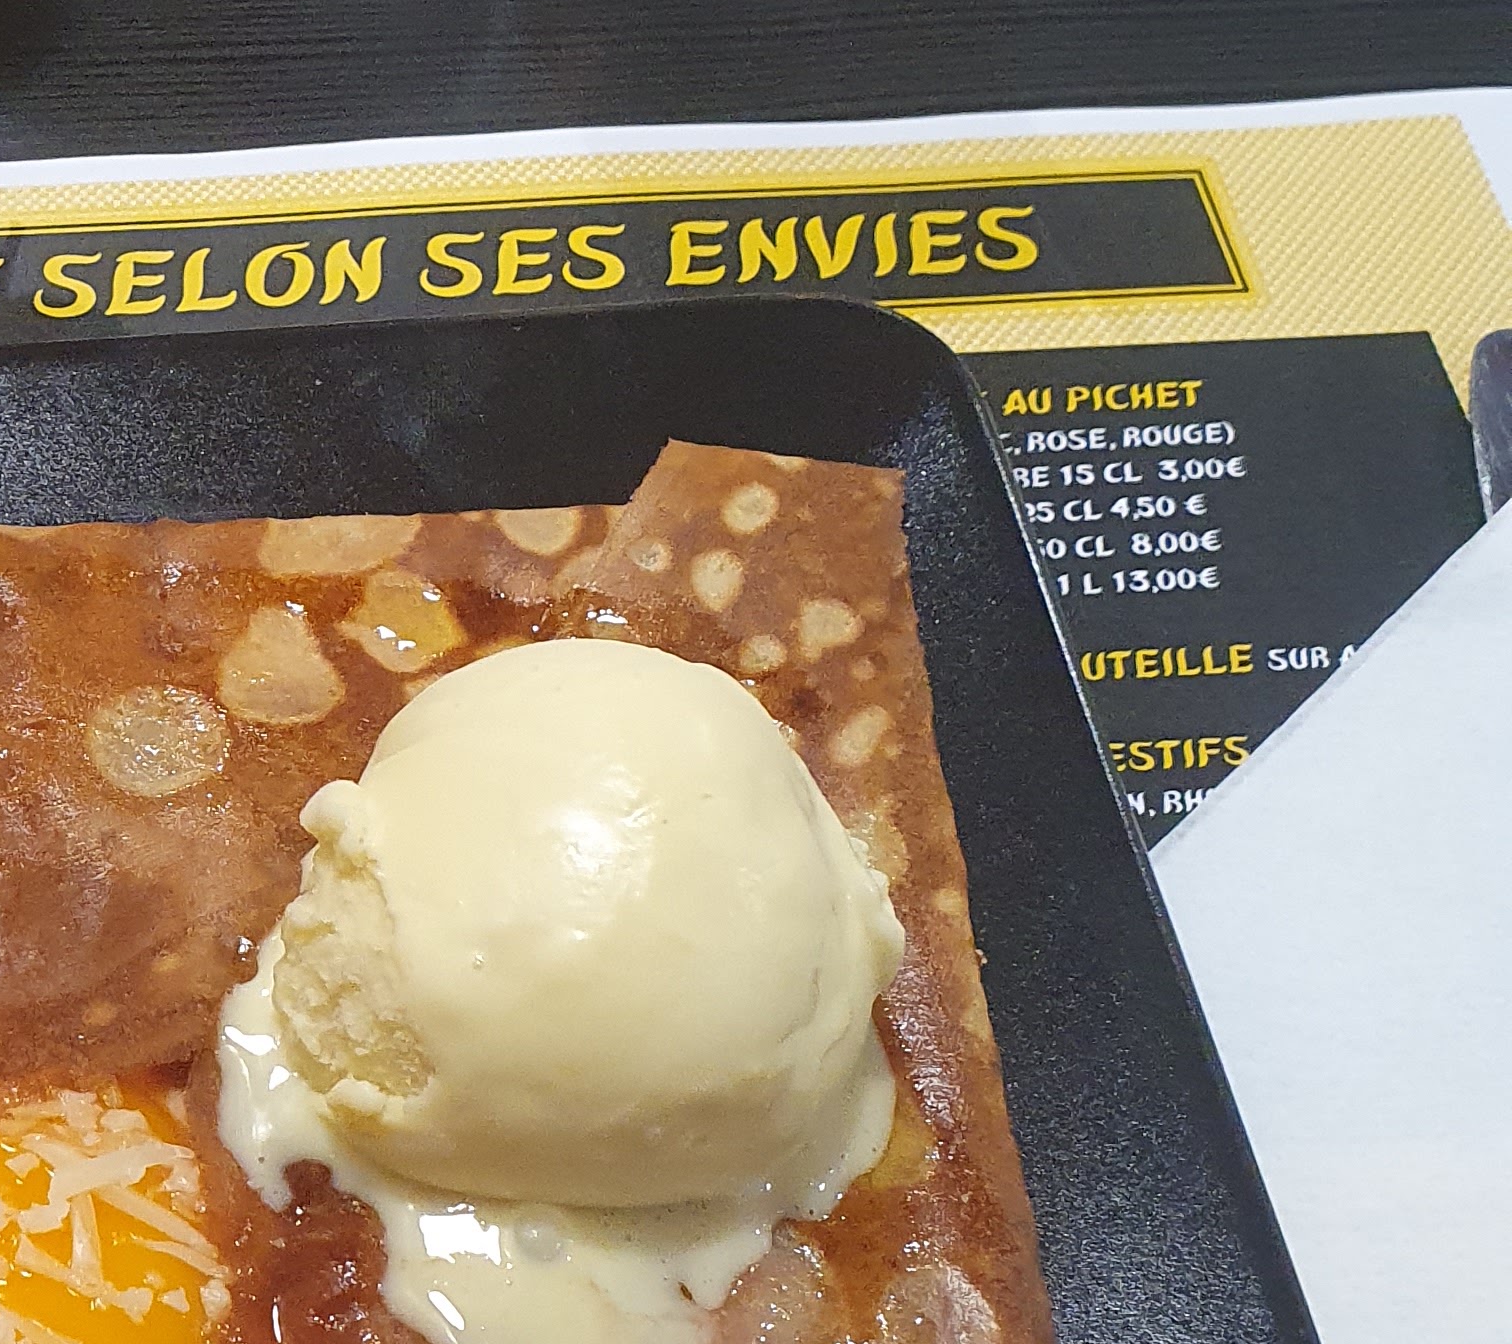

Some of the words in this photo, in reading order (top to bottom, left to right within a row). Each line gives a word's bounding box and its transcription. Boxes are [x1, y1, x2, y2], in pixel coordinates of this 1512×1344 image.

[33, 234, 387, 321] SELON
[419, 224, 627, 299] SES
[664, 205, 1039, 288] ENVIES
[1002, 387, 1052, 417] AU
[1066, 379, 1204, 413] PICHET
[1026, 427, 1118, 454] ROSE,
[1122, 420, 1236, 449] ROUGE)
[1060, 463, 1096, 487] 15
[1103, 461, 1143, 484] CL
[1157, 456, 1247, 483] 3,00€
[1063, 499, 1103, 522] CL
[1109, 495, 1177, 522] 4,50
[1074, 535, 1116, 558] CL
[1129, 527, 1223, 557] 8,00€
[1057, 573, 1070, 596] 1
[1082, 572, 1103, 595] L
[1111, 566, 1222, 594] 13,00€
[1080, 643, 1254, 681] UTEILLE
[1267, 646, 1331, 673] SUR
